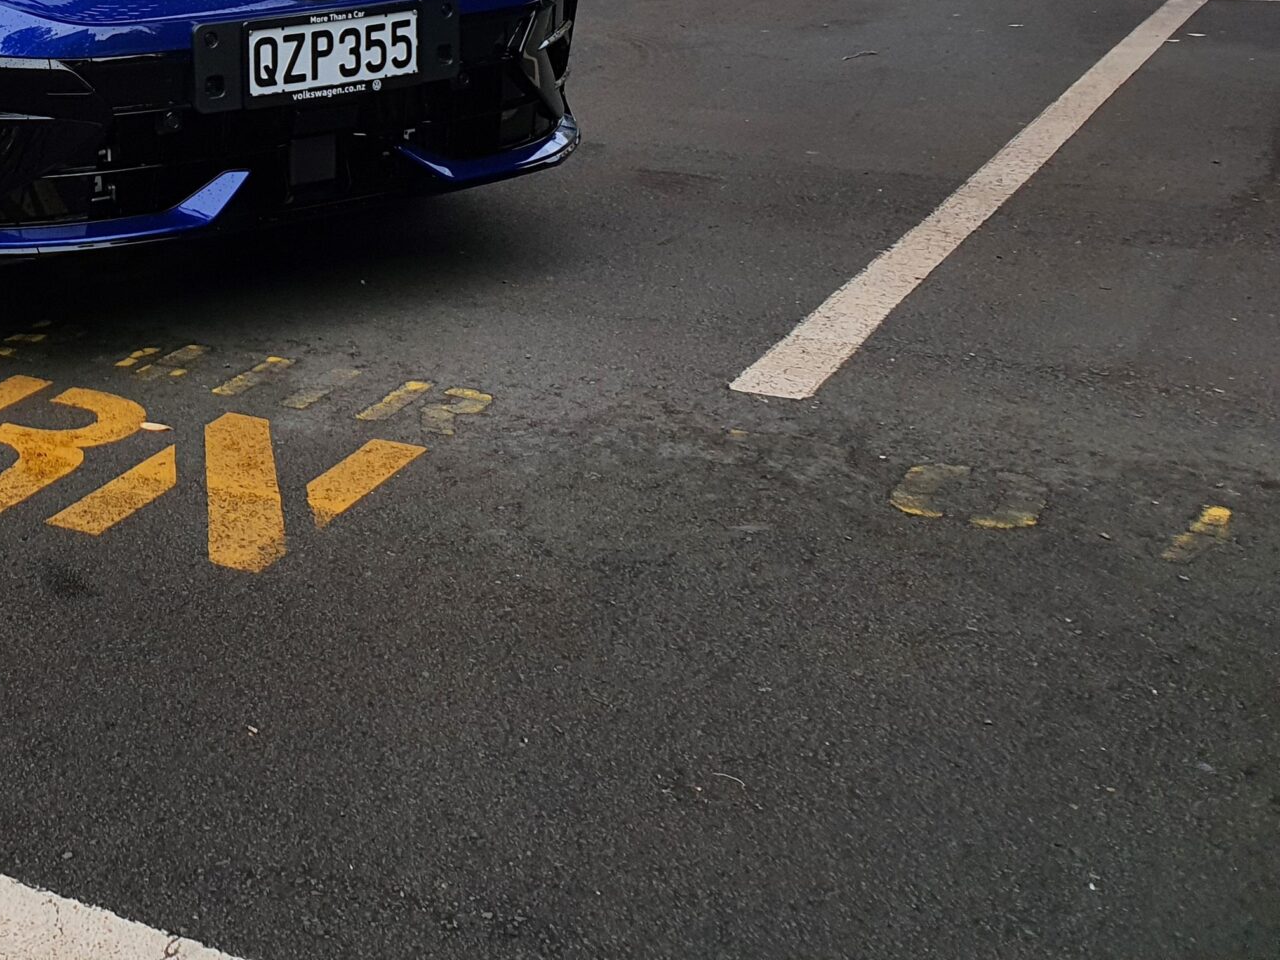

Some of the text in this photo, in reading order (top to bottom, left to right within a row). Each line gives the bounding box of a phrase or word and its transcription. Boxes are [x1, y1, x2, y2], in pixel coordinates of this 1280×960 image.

[309, 15, 328, 24] More
[330, 13, 347, 21] Than
[353, 10, 365, 18] Car
[253, 19, 413, 88] QZP355
[292, 82, 366, 101] volkswagen.co.nz
